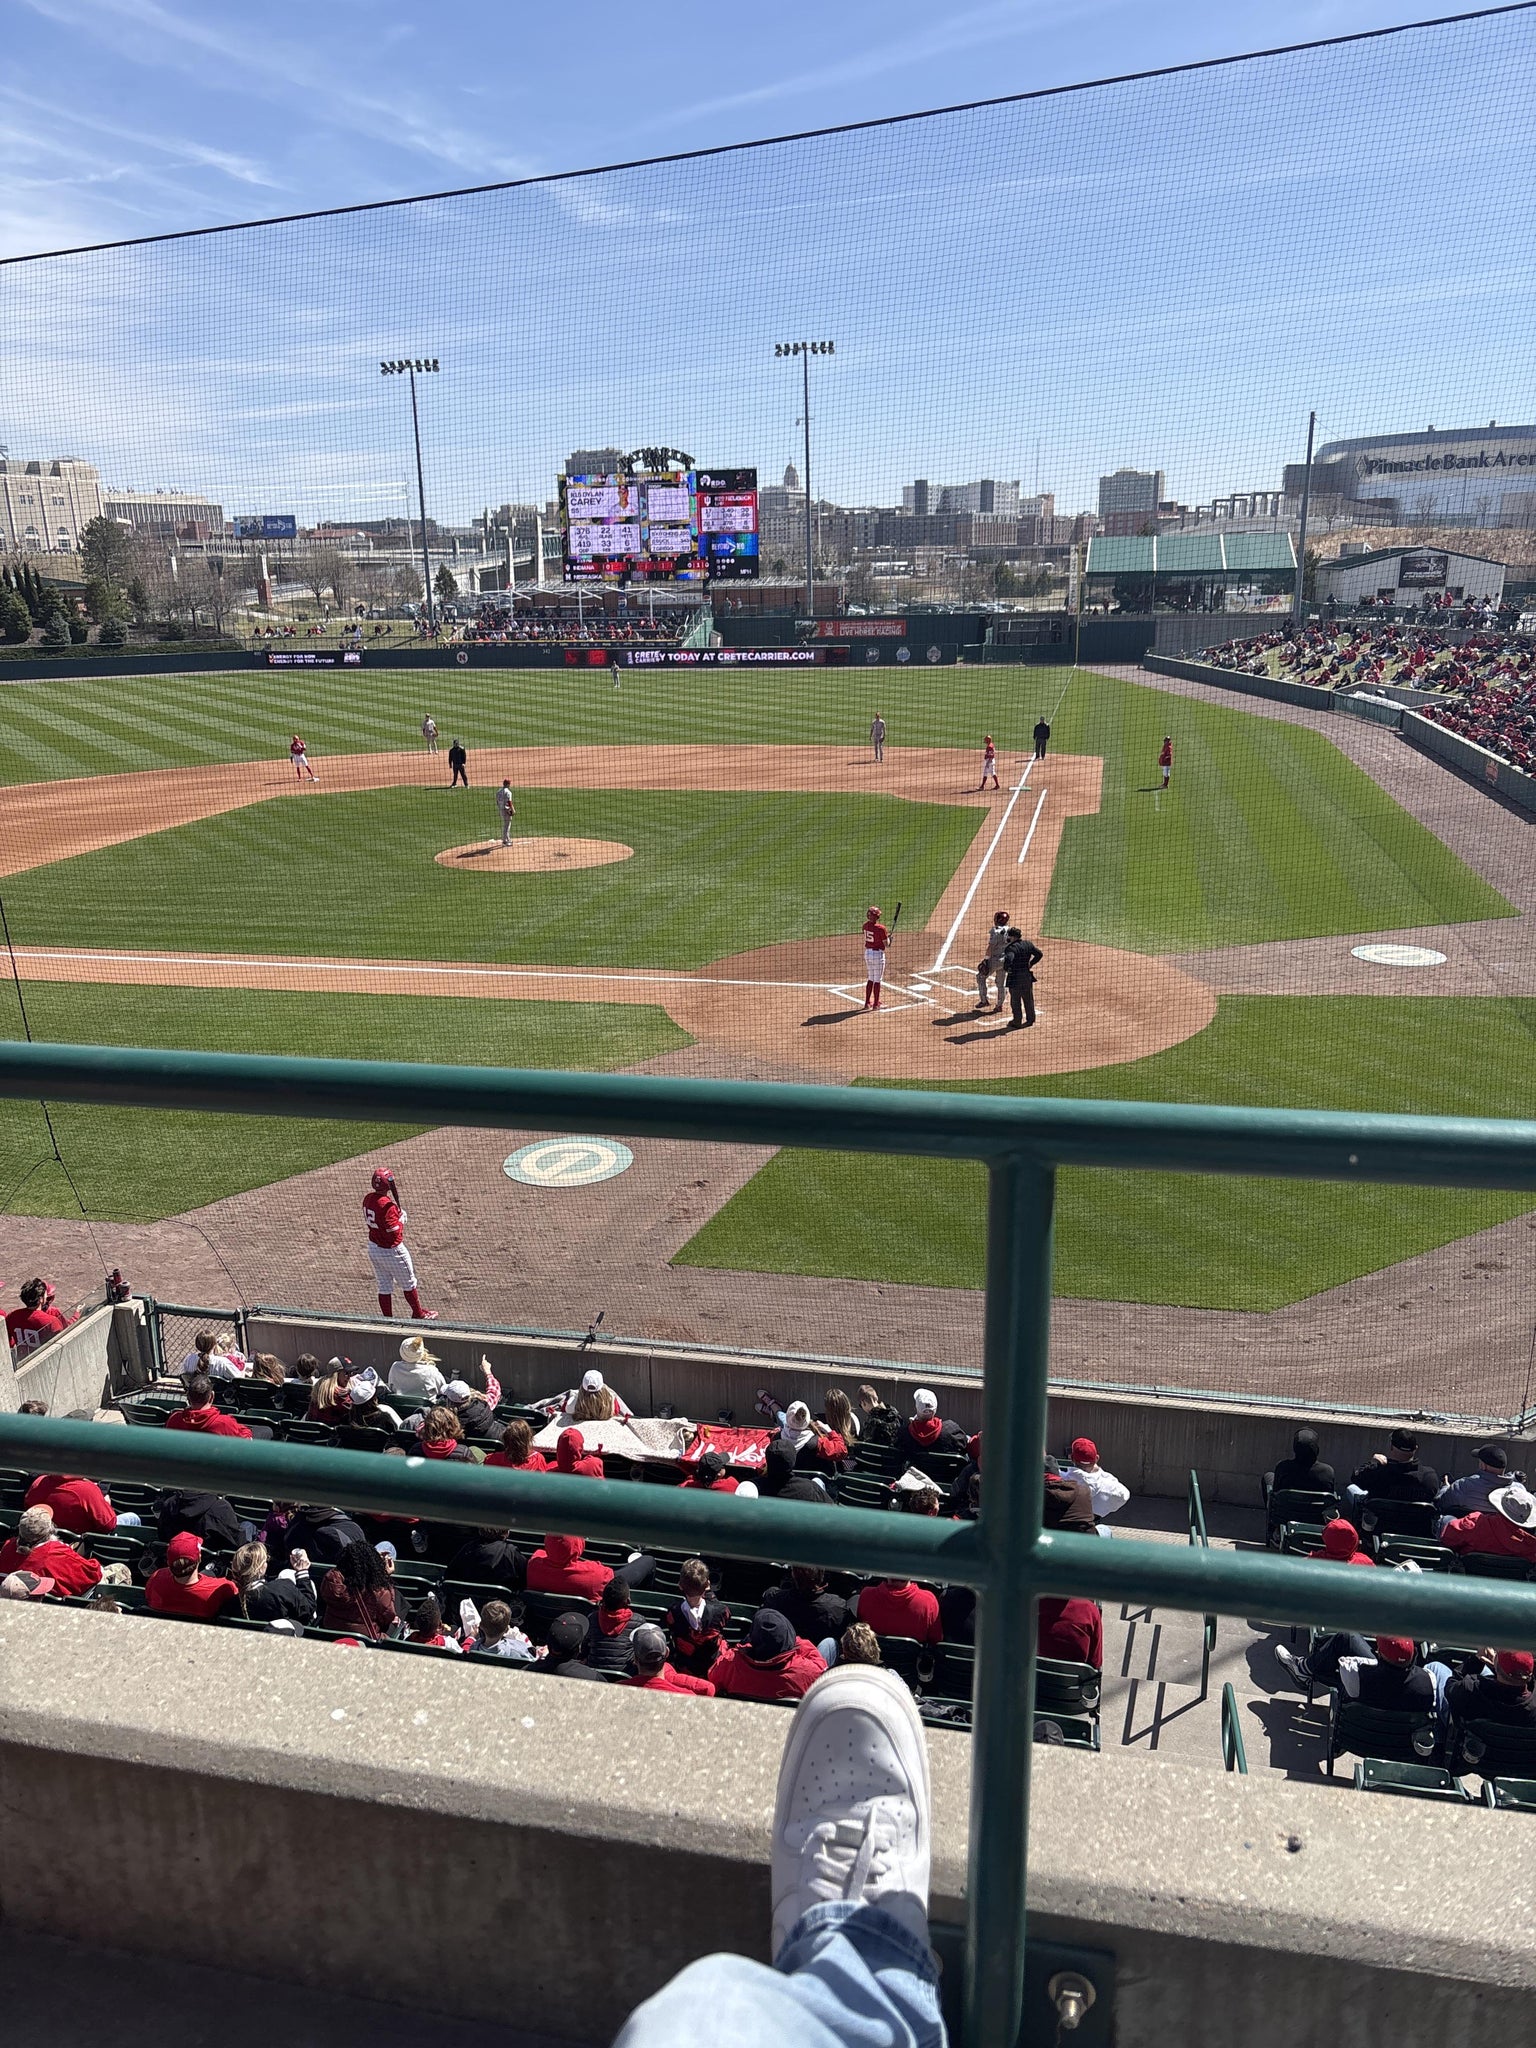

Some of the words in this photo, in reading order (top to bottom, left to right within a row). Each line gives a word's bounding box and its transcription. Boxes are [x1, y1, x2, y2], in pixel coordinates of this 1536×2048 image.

[1368, 455, 1440, 475] Pinnacle
[1443, 451, 1489, 470] Bank
[570, 498, 602, 506] CAREY
[668, 653, 701, 661] TODAY
[702, 653, 715, 661] AT
[717, 652, 815, 661] CRETECARRIER.COM
[13, 1327, 40, 1347] 10
